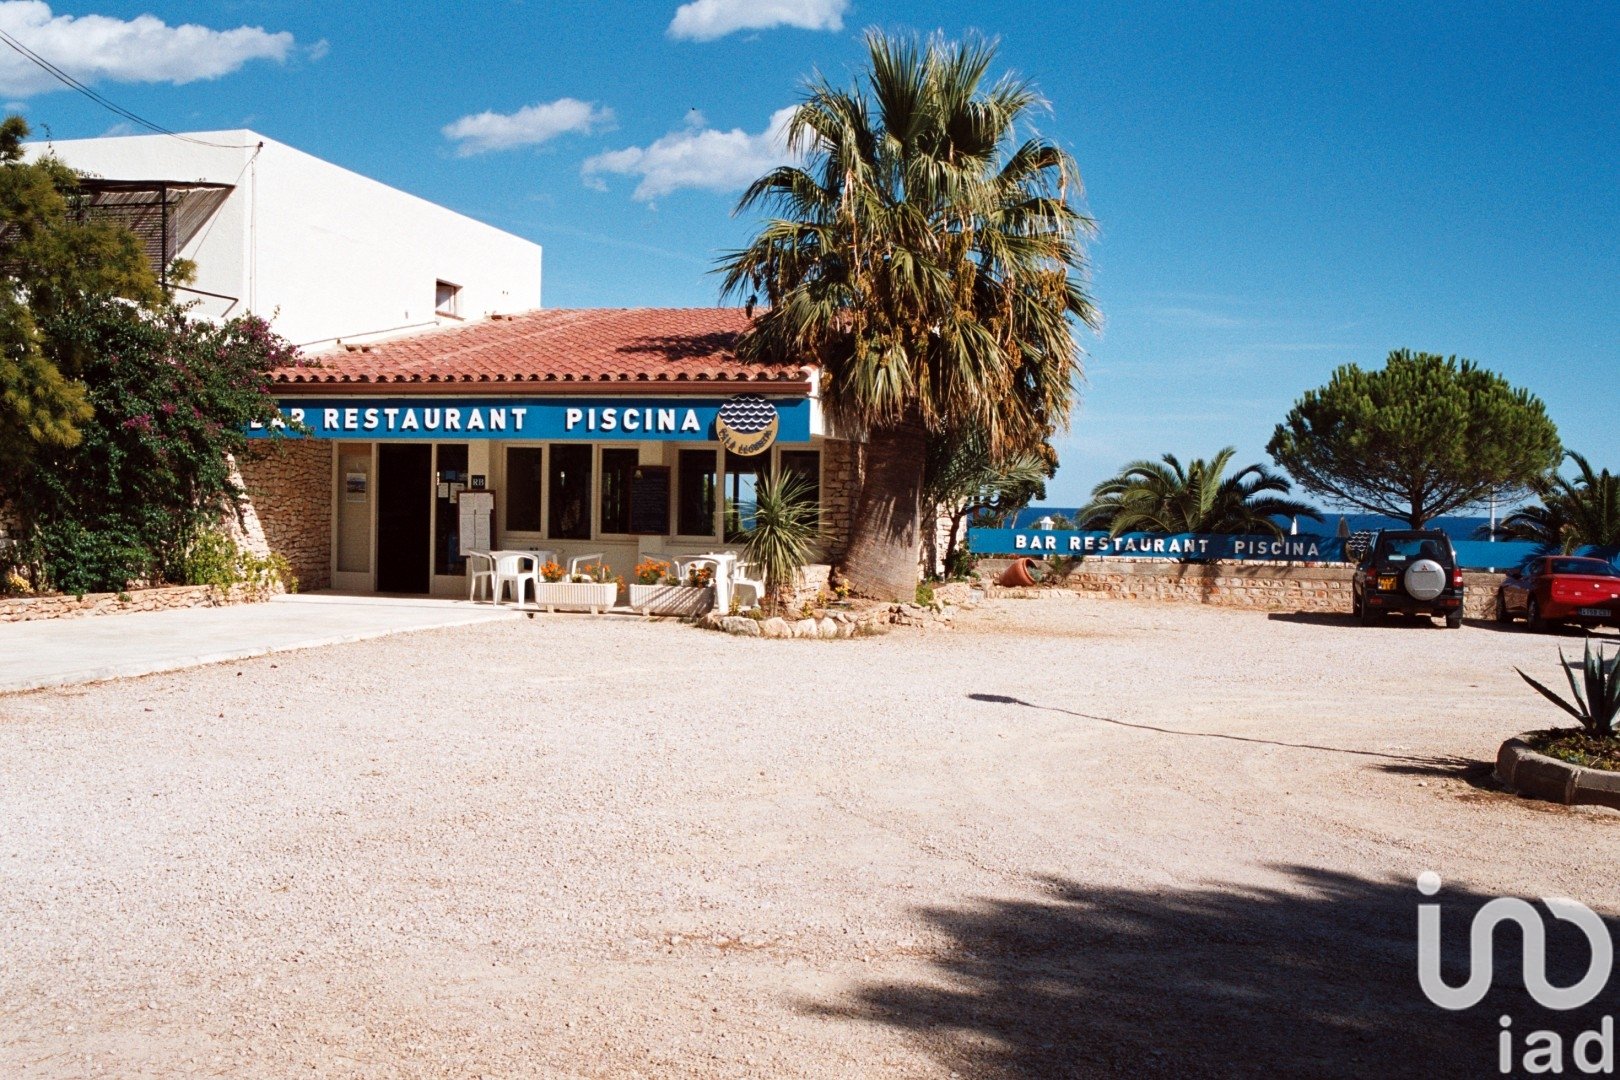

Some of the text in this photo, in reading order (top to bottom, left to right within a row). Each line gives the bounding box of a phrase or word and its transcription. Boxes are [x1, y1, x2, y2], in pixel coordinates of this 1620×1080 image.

[324, 408, 527, 429] RESTAURANT
[566, 408, 701, 431] PISCINA
[1015, 534, 1319, 556] BAR RESTAURANT PISCINA
